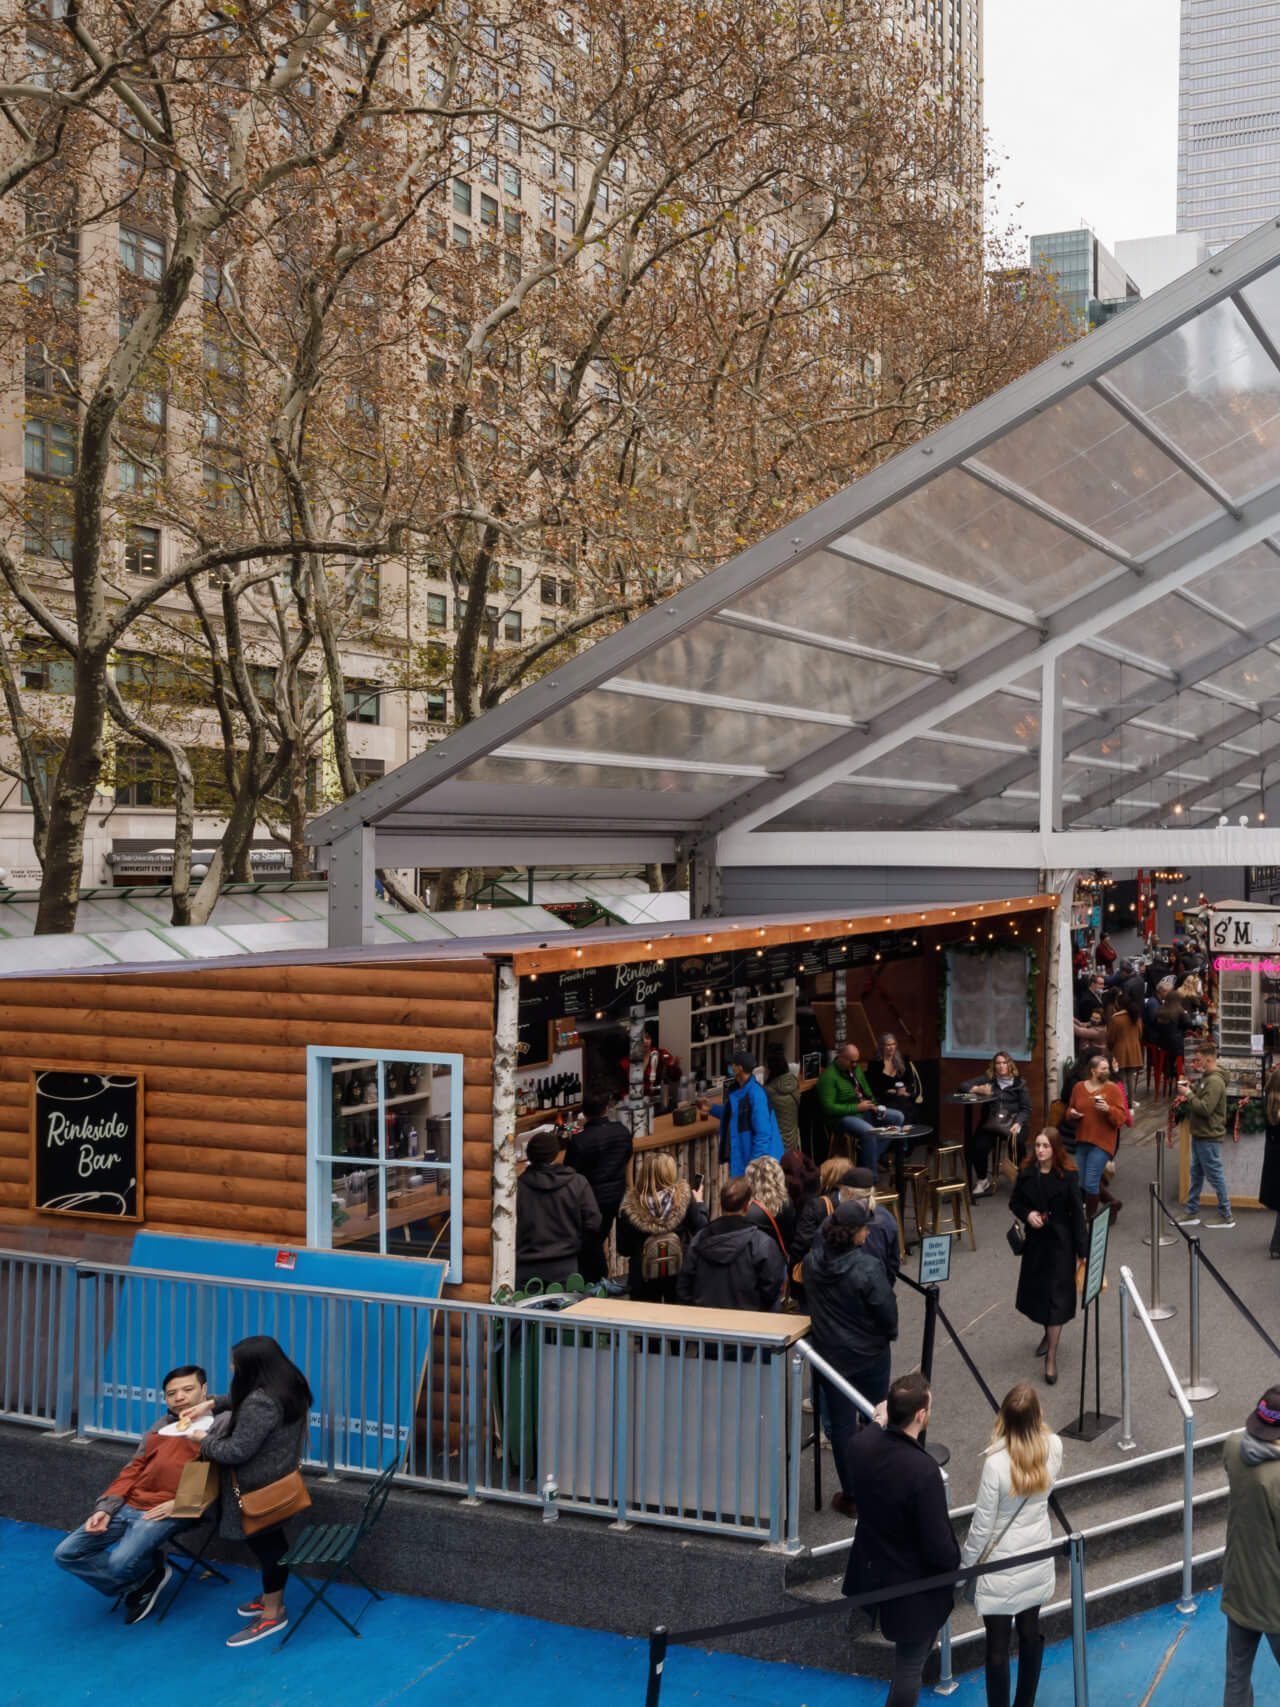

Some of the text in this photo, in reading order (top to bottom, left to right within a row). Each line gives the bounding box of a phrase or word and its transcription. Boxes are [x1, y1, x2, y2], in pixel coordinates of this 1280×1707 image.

[162, 865, 173, 873] CEN
[616, 962, 666, 989] Rinkside
[635, 979, 662, 1002] Bar
[47, 1112, 128, 1148] Rinkside
[78, 1144, 121, 1177] Bar
